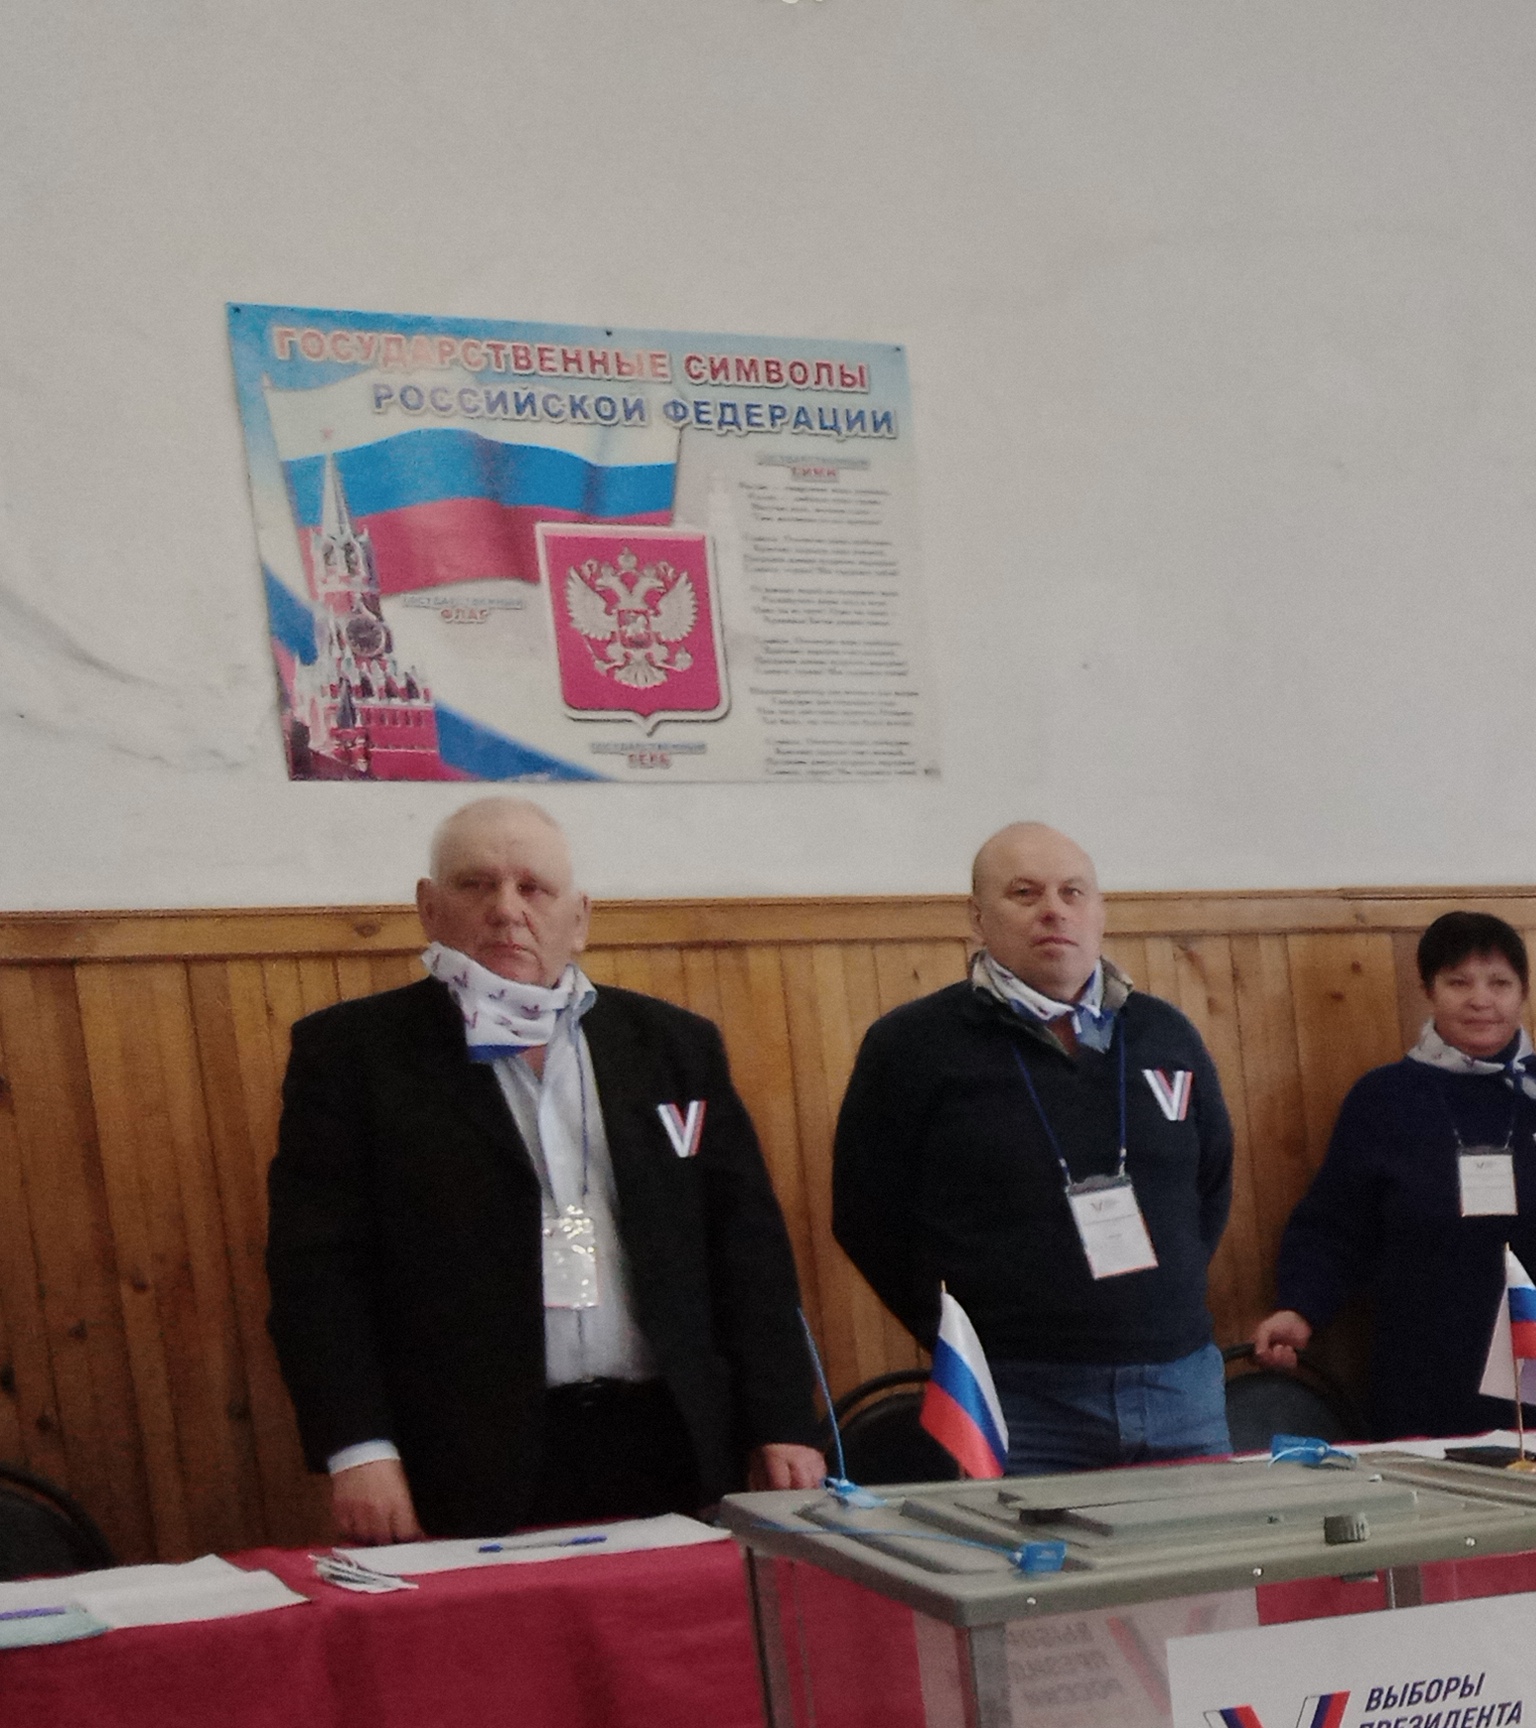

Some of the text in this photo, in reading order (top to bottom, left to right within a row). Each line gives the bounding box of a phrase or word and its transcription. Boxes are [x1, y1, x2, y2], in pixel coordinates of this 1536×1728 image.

[272, 327, 870, 392] ГОСУДАРСТВЕННЫЕ СИМВОЛЫ
[372, 381, 897, 441] РОССИЙСКОЙ ФЕДЕРАЦИИ
[1365, 1672, 1485, 1712] ВЫБОРЫ
